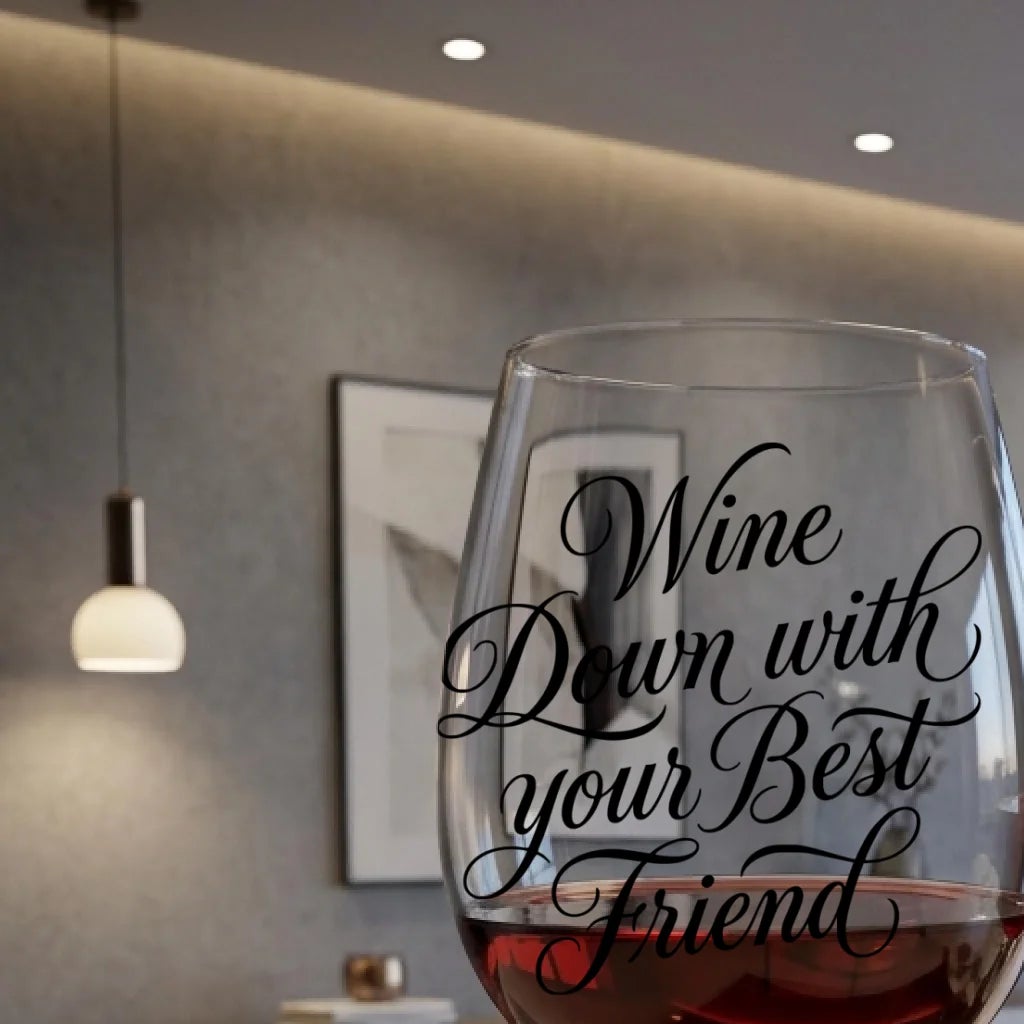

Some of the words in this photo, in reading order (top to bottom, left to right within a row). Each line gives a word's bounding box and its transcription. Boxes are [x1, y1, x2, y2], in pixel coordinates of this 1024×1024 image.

[560, 442, 843, 601] Wine
[438, 590, 752, 741] Down
[764, 525, 982, 682] with
[463, 747, 701, 900] your
[697, 690, 981, 833] Best
[536, 807, 921, 995] Friend
